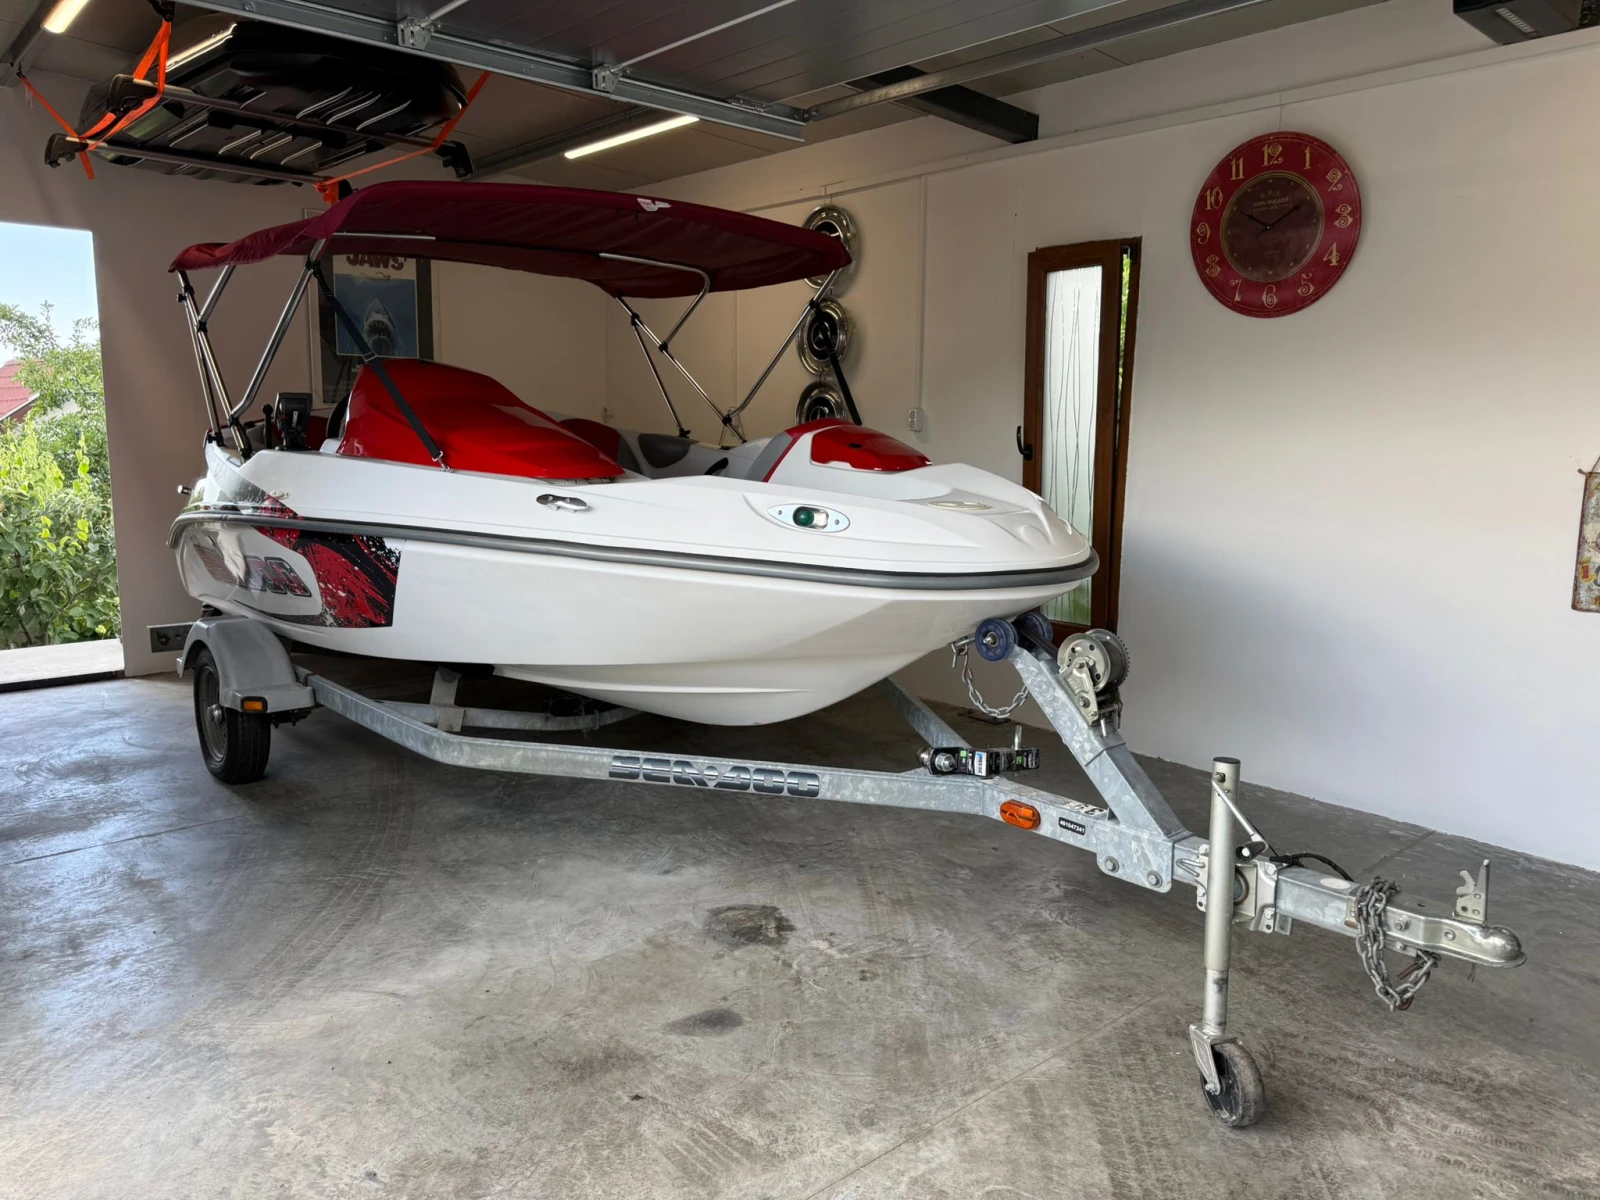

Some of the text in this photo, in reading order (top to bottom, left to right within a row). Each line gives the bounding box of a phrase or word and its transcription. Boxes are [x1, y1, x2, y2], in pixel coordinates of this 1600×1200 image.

[1261, 142, 1283, 167] 12
[1302, 146, 1312, 170] 1
[1229, 156, 1245, 181] 11
[1325, 168, 1343, 192] 2
[1204, 186, 1224, 211] 10
[1333, 203, 1354, 228] 3
[1195, 221, 1211, 245] 9
[1204, 253, 1221, 278] 8
[1322, 241, 1341, 267] 4
[1229, 279, 1242, 302] 7
[1261, 284, 1279, 309] 6
[1296, 272, 1315, 297] 5
